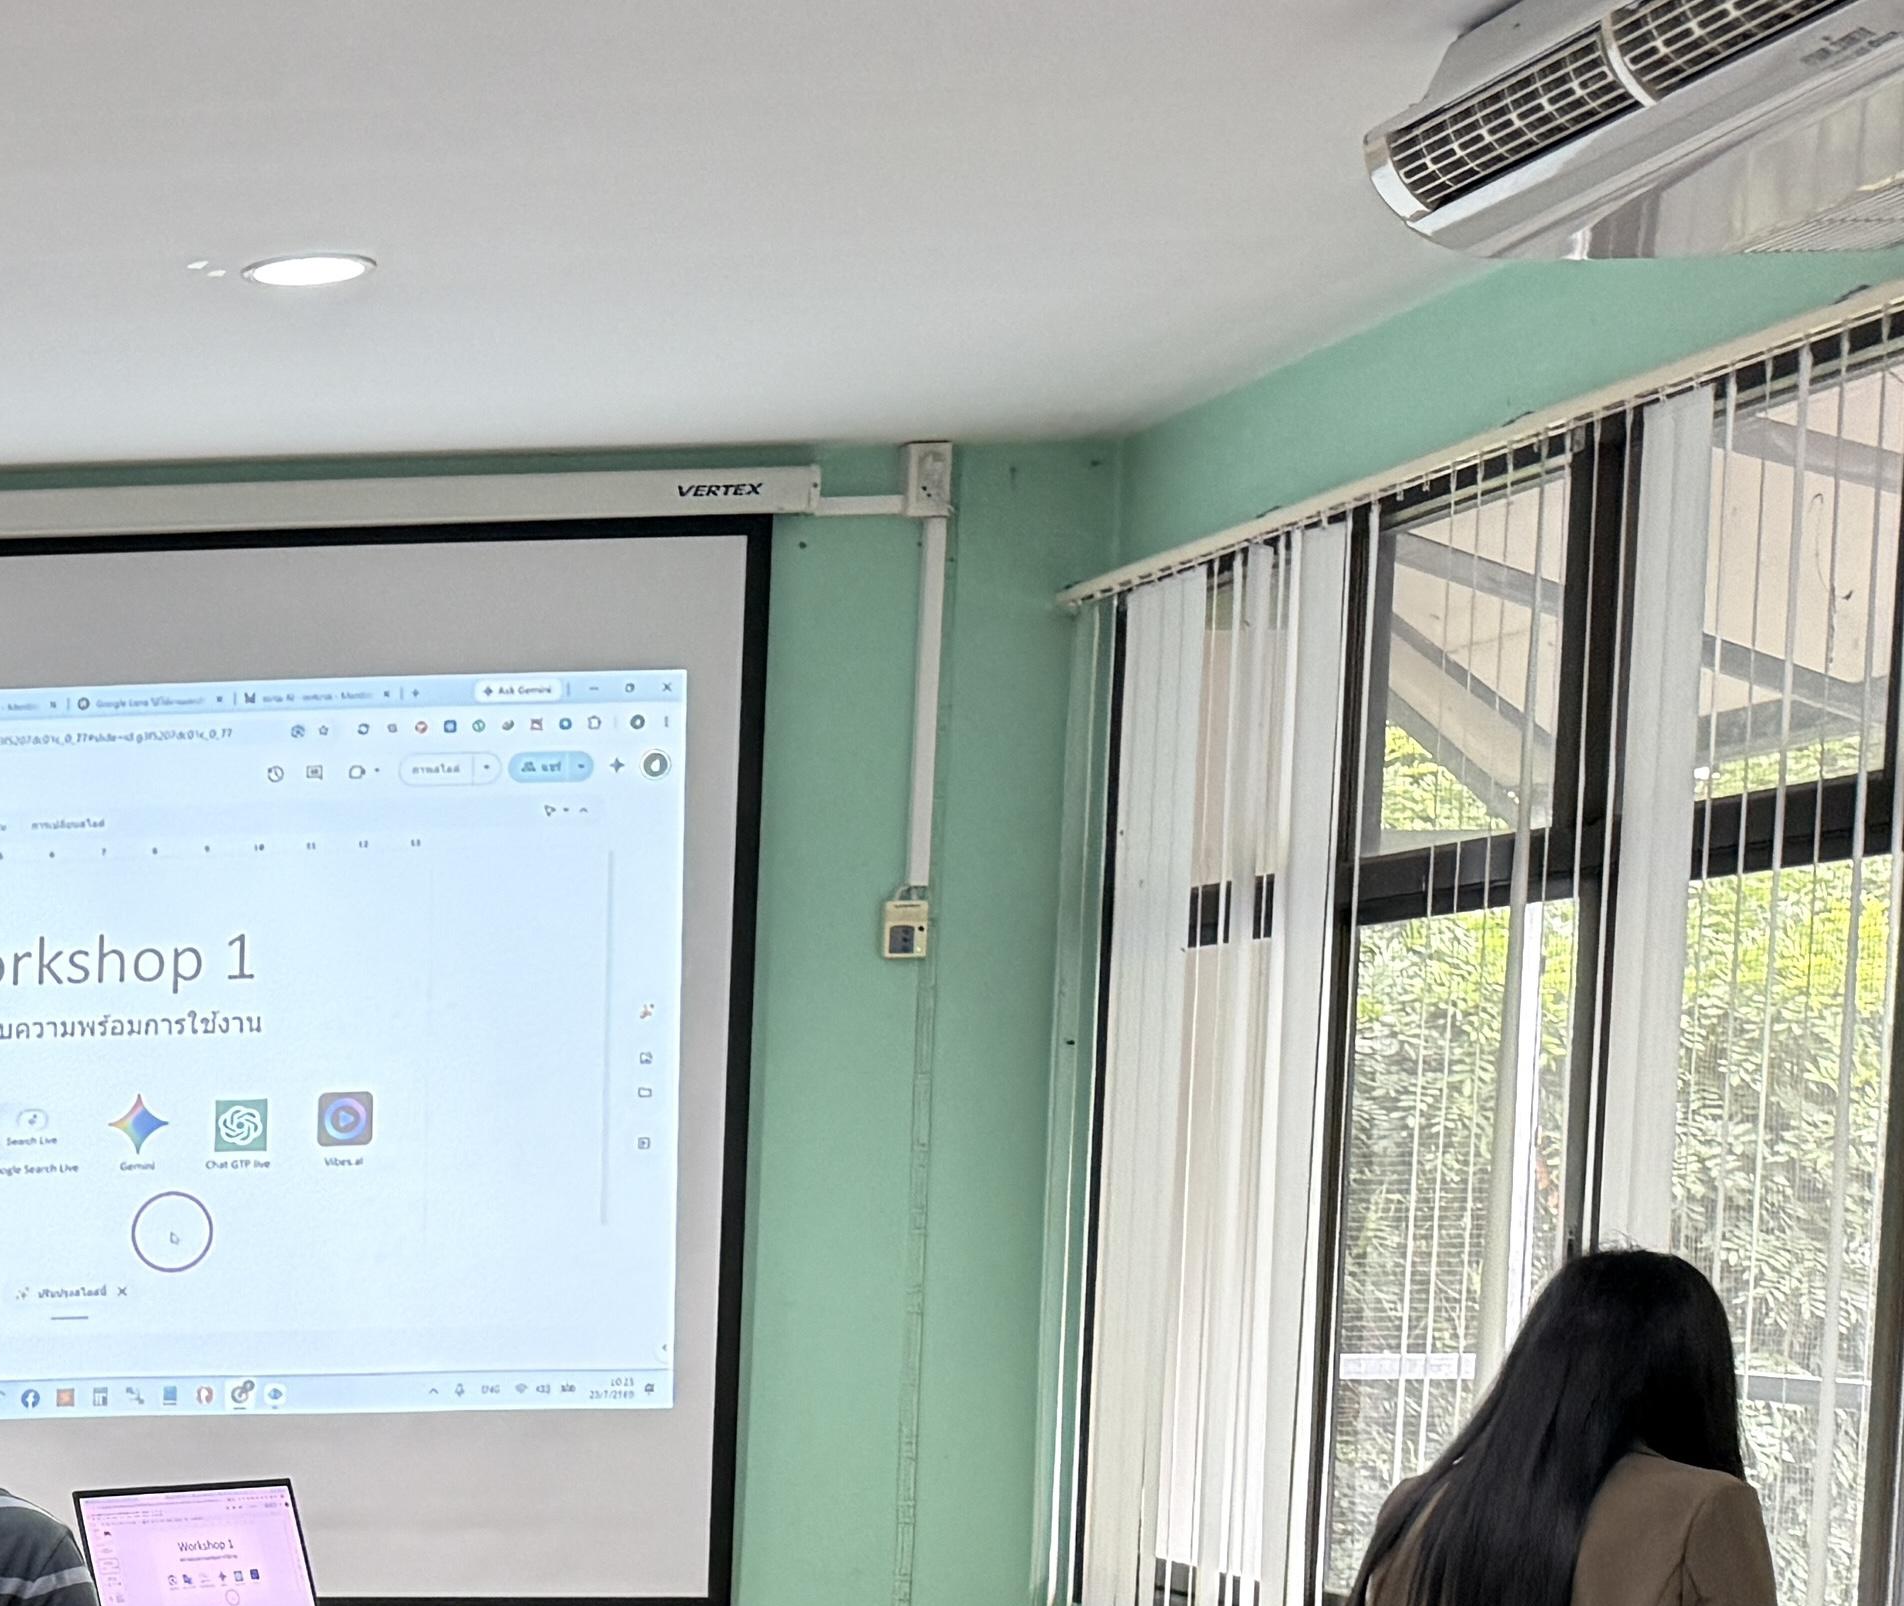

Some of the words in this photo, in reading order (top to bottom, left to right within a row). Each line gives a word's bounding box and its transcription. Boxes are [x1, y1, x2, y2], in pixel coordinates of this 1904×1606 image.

[677, 482, 764, 498] VERTEX
[226, 933, 257, 981] 1
[6, 1137, 37, 1146] Search
[39, 1136, 58, 1145] Live
[24, 1164, 57, 1174] Search
[59, 1163, 79, 1173] Live
[120, 1160, 155, 1171] Gemini
[205, 1159, 228, 1170] Chat
[177, 1539, 226, 1552] Workshop
